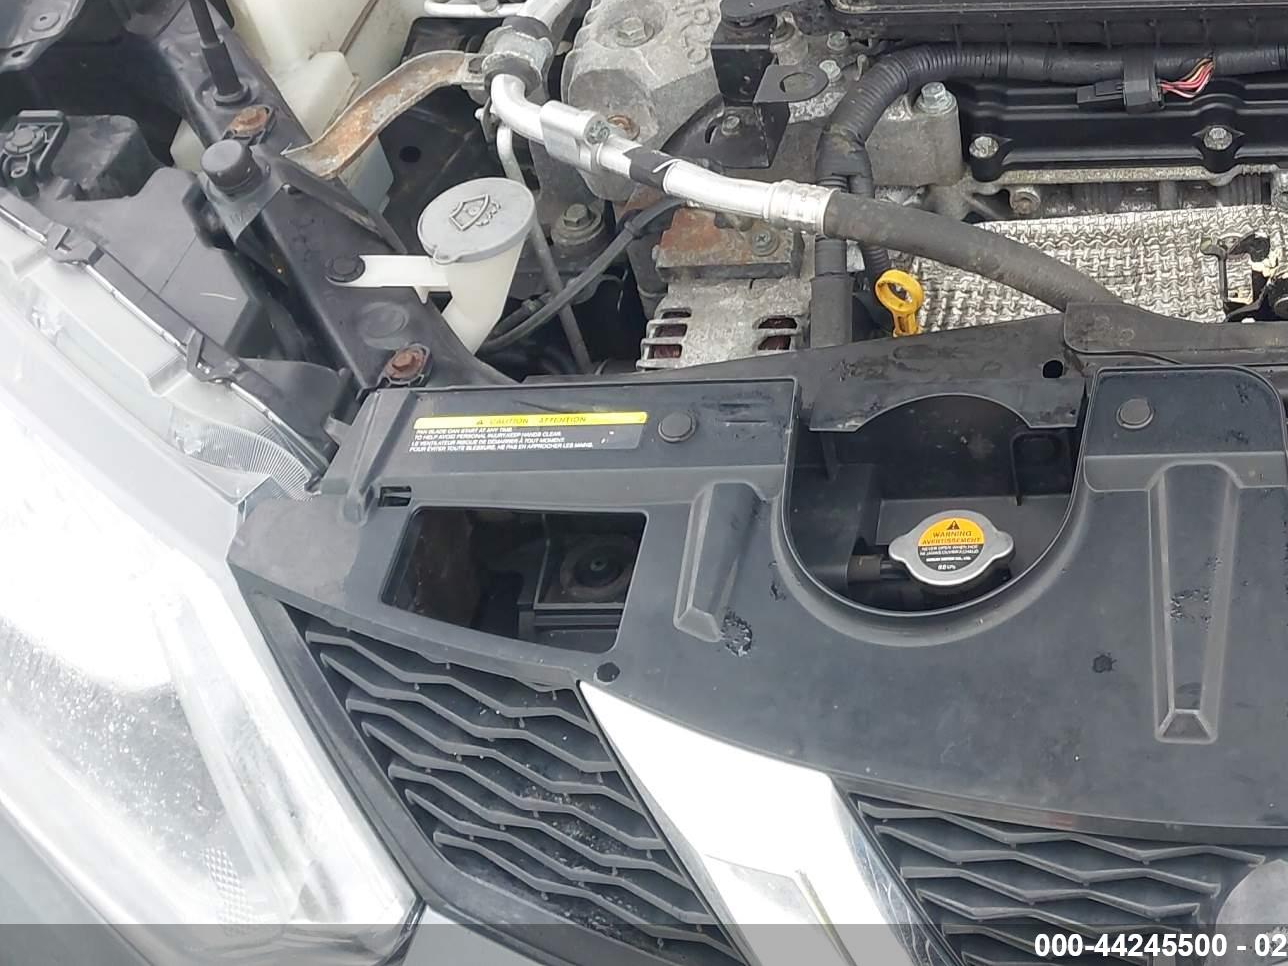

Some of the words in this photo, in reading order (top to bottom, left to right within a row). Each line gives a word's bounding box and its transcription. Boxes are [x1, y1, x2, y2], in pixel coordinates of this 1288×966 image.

[489, 417, 529, 425] CAUTION
[538, 416, 587, 424] ATTENTION
[922, 537, 981, 545] AVERTISSEMENT
